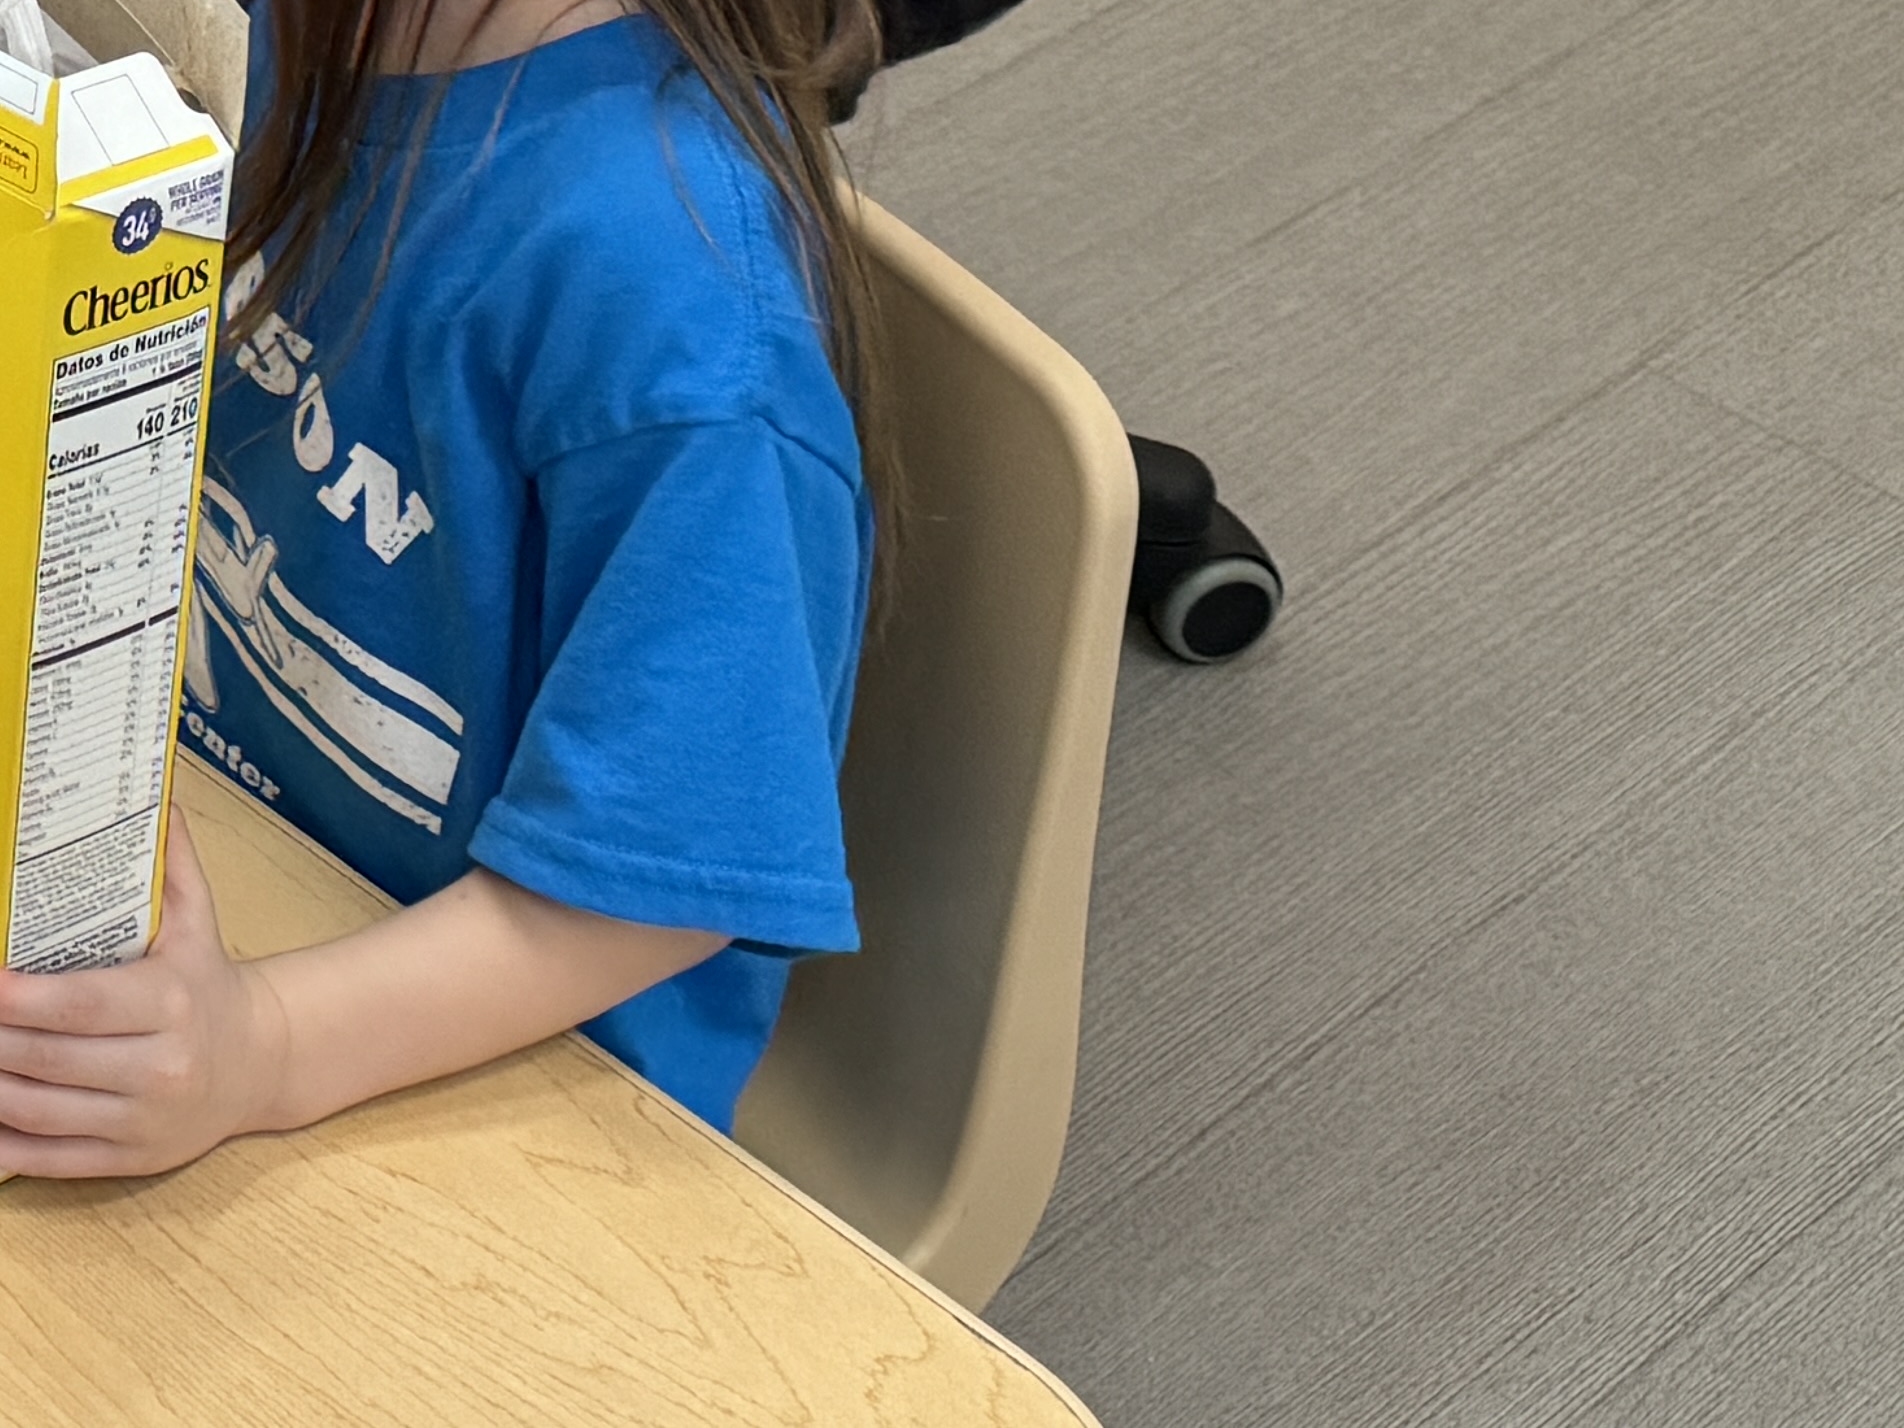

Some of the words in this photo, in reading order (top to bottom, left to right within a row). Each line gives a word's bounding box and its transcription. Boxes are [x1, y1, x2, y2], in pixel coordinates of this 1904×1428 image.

[63, 257, 209, 336] Cheerios
[56, 353, 104, 380] Datos
[109, 343, 130, 362] de
[135, 315, 207, 354] Nutrición
[136, 410, 166, 441] 140
[170, 396, 199, 427] 210
[181, 708, 282, 801] enter
